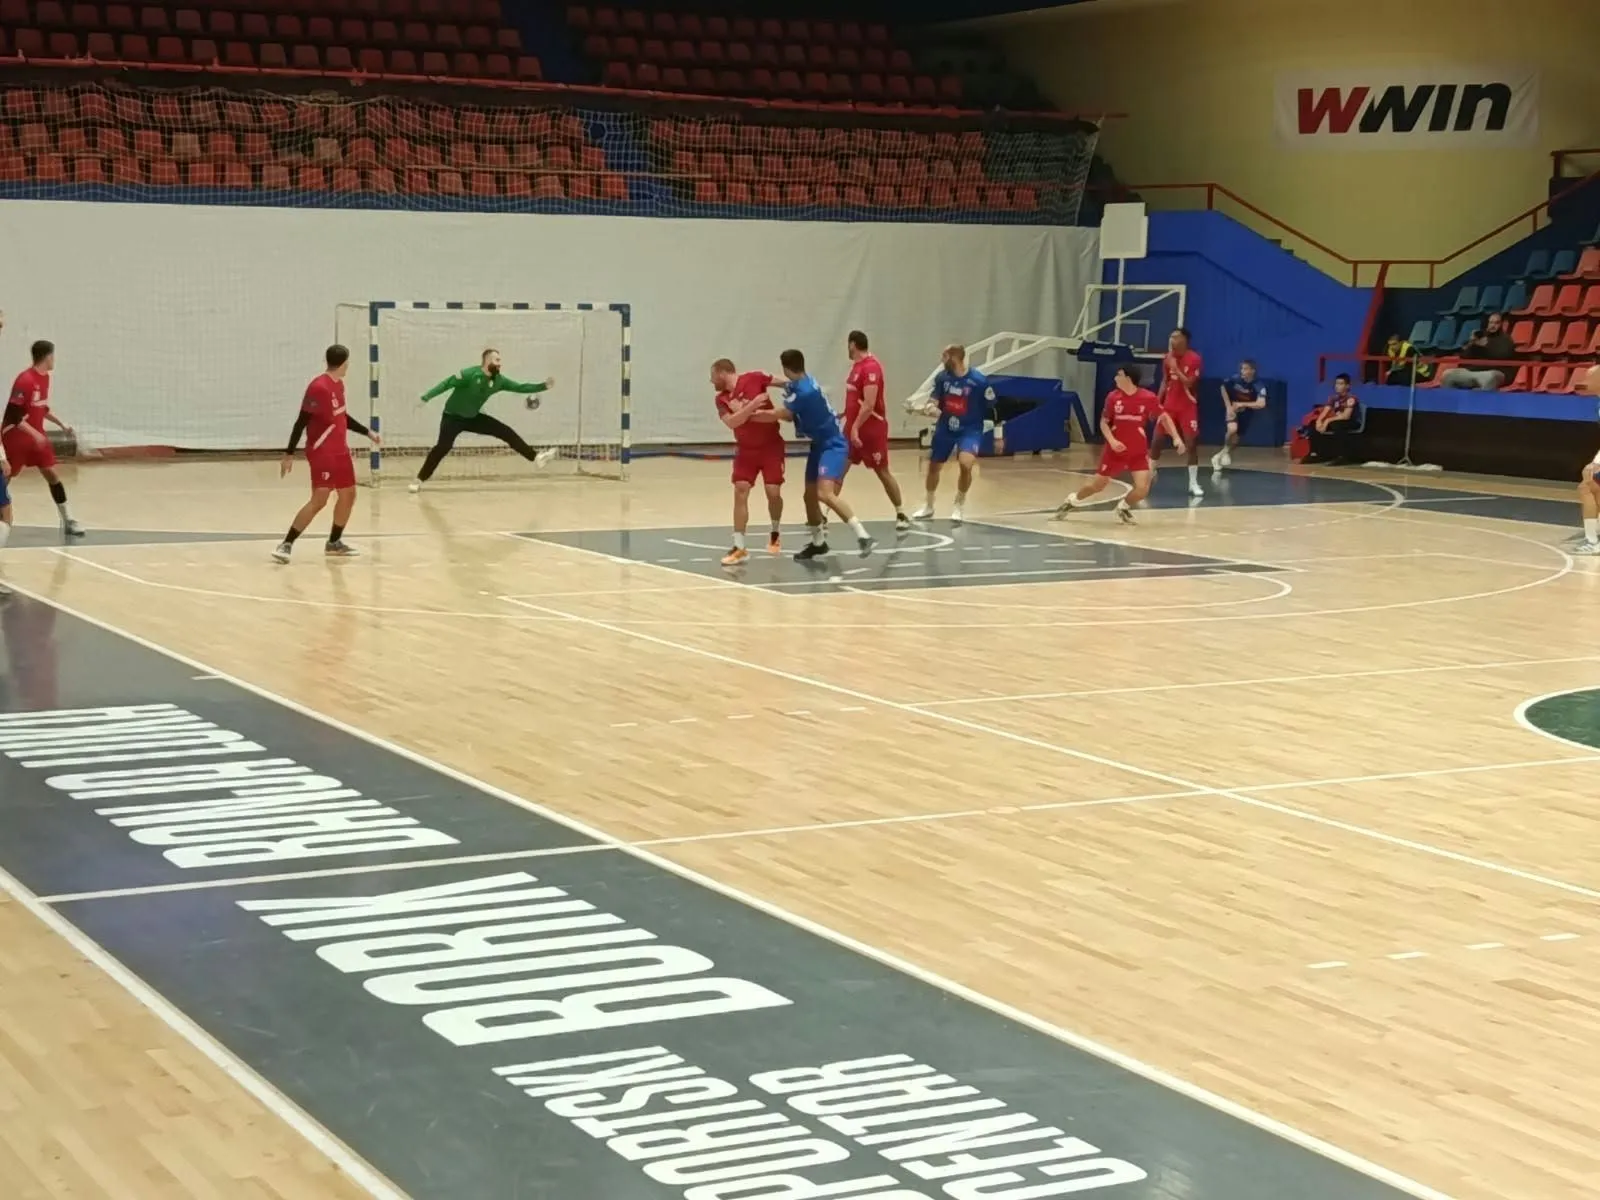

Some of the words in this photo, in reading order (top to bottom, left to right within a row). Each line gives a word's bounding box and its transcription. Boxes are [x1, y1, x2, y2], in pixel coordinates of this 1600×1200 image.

[45, 757, 461, 869] BANJA
[235, 871, 795, 1046] BORIK
[491, 1045, 934, 1200] PORTSKI
[748, 1053, 1148, 1200] CENTAR
